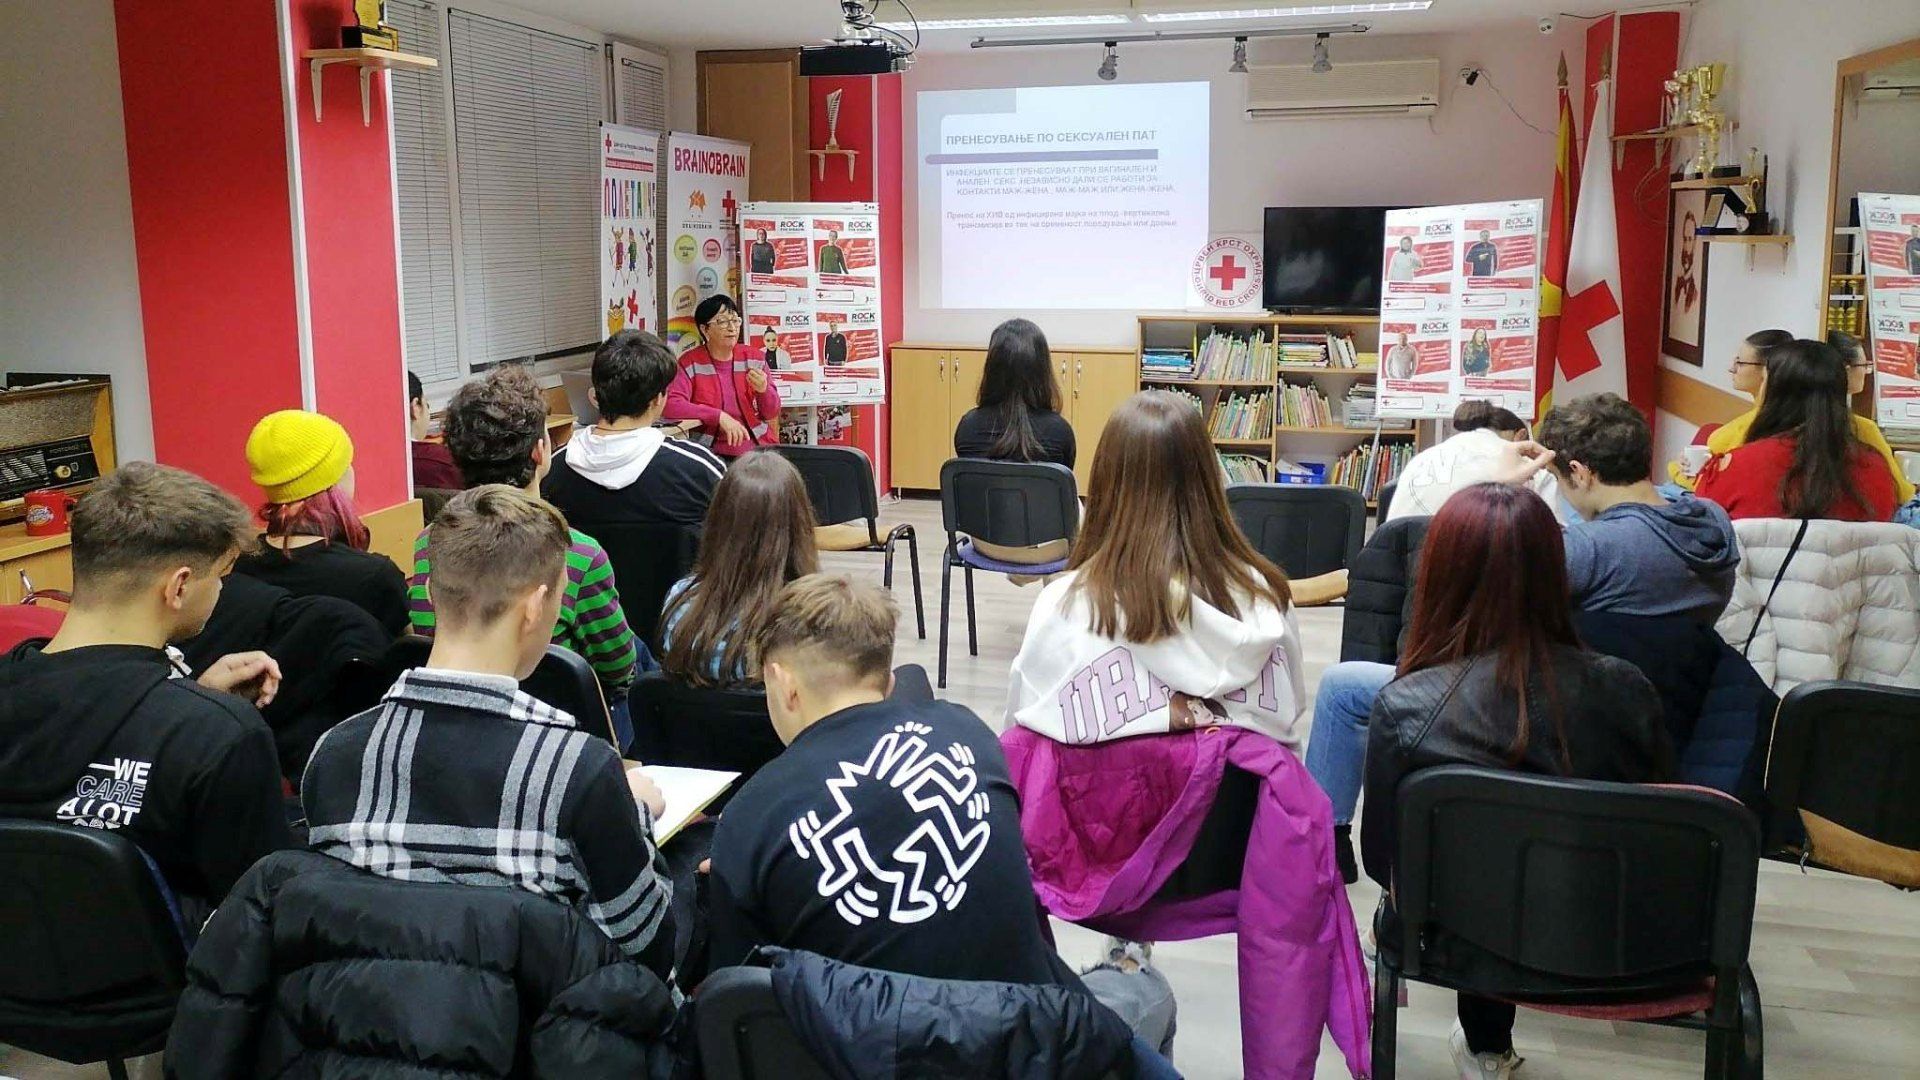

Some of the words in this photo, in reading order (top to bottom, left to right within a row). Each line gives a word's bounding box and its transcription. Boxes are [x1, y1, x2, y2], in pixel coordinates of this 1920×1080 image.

[946, 134, 1034, 145] ПРЕНЕСУВАЊЕ
[1037, 133, 1054, 143] ПО
[1057, 131, 1129, 142] СЕКСУАЛЕН
[1132, 130, 1157, 140] ПАТ
[674, 147, 746, 178] BRAINOBRAIN
[1194, 245, 1214, 275] ЦРВЕН
[1216, 240, 1241, 248] КРСТ
[1243, 245, 1263, 275] ОХРИД
[1238, 279, 1261, 303] CROSS
[851, 312, 875, 320] ROCK
[1422, 321, 1449, 330] ROCK
[114, 757, 152, 785] WE
[77, 775, 146, 807] CARE
